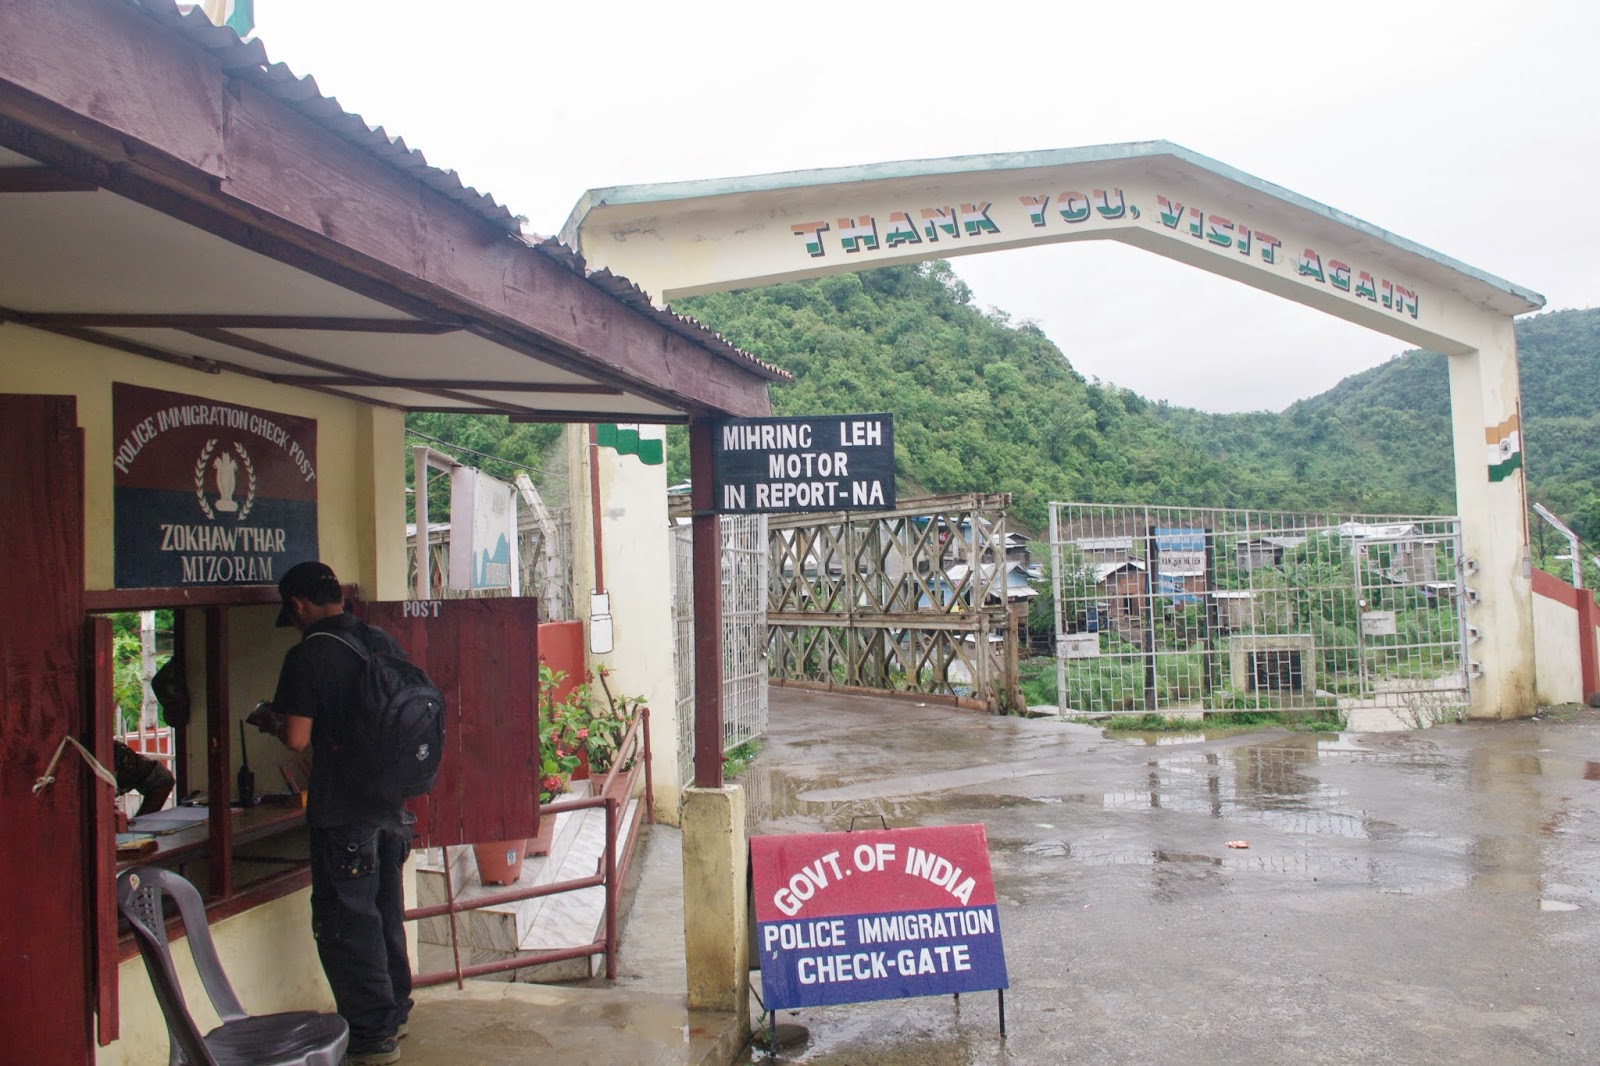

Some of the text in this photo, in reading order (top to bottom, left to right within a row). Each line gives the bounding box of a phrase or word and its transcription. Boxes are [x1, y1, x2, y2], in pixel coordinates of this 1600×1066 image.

[790, 187, 1419, 320] THANK YOU, VISIT AGAIN
[114, 404, 316, 483] POLICE IMMIGRATION CHECK POST
[840, 421, 882, 447] LEH
[769, 451, 849, 478] MOTOR
[724, 480, 885, 510] IN REPORT-NA
[160, 523, 286, 553] ZOKHAWTHAR
[181, 555, 274, 583] MIZORAM
[402, 600, 443, 618] POST
[773, 843, 976, 917] GOVT. OF INDIA
[764, 908, 995, 952] POLICE IMMIGRATION
[797, 944, 972, 985] CHECK-GATE
